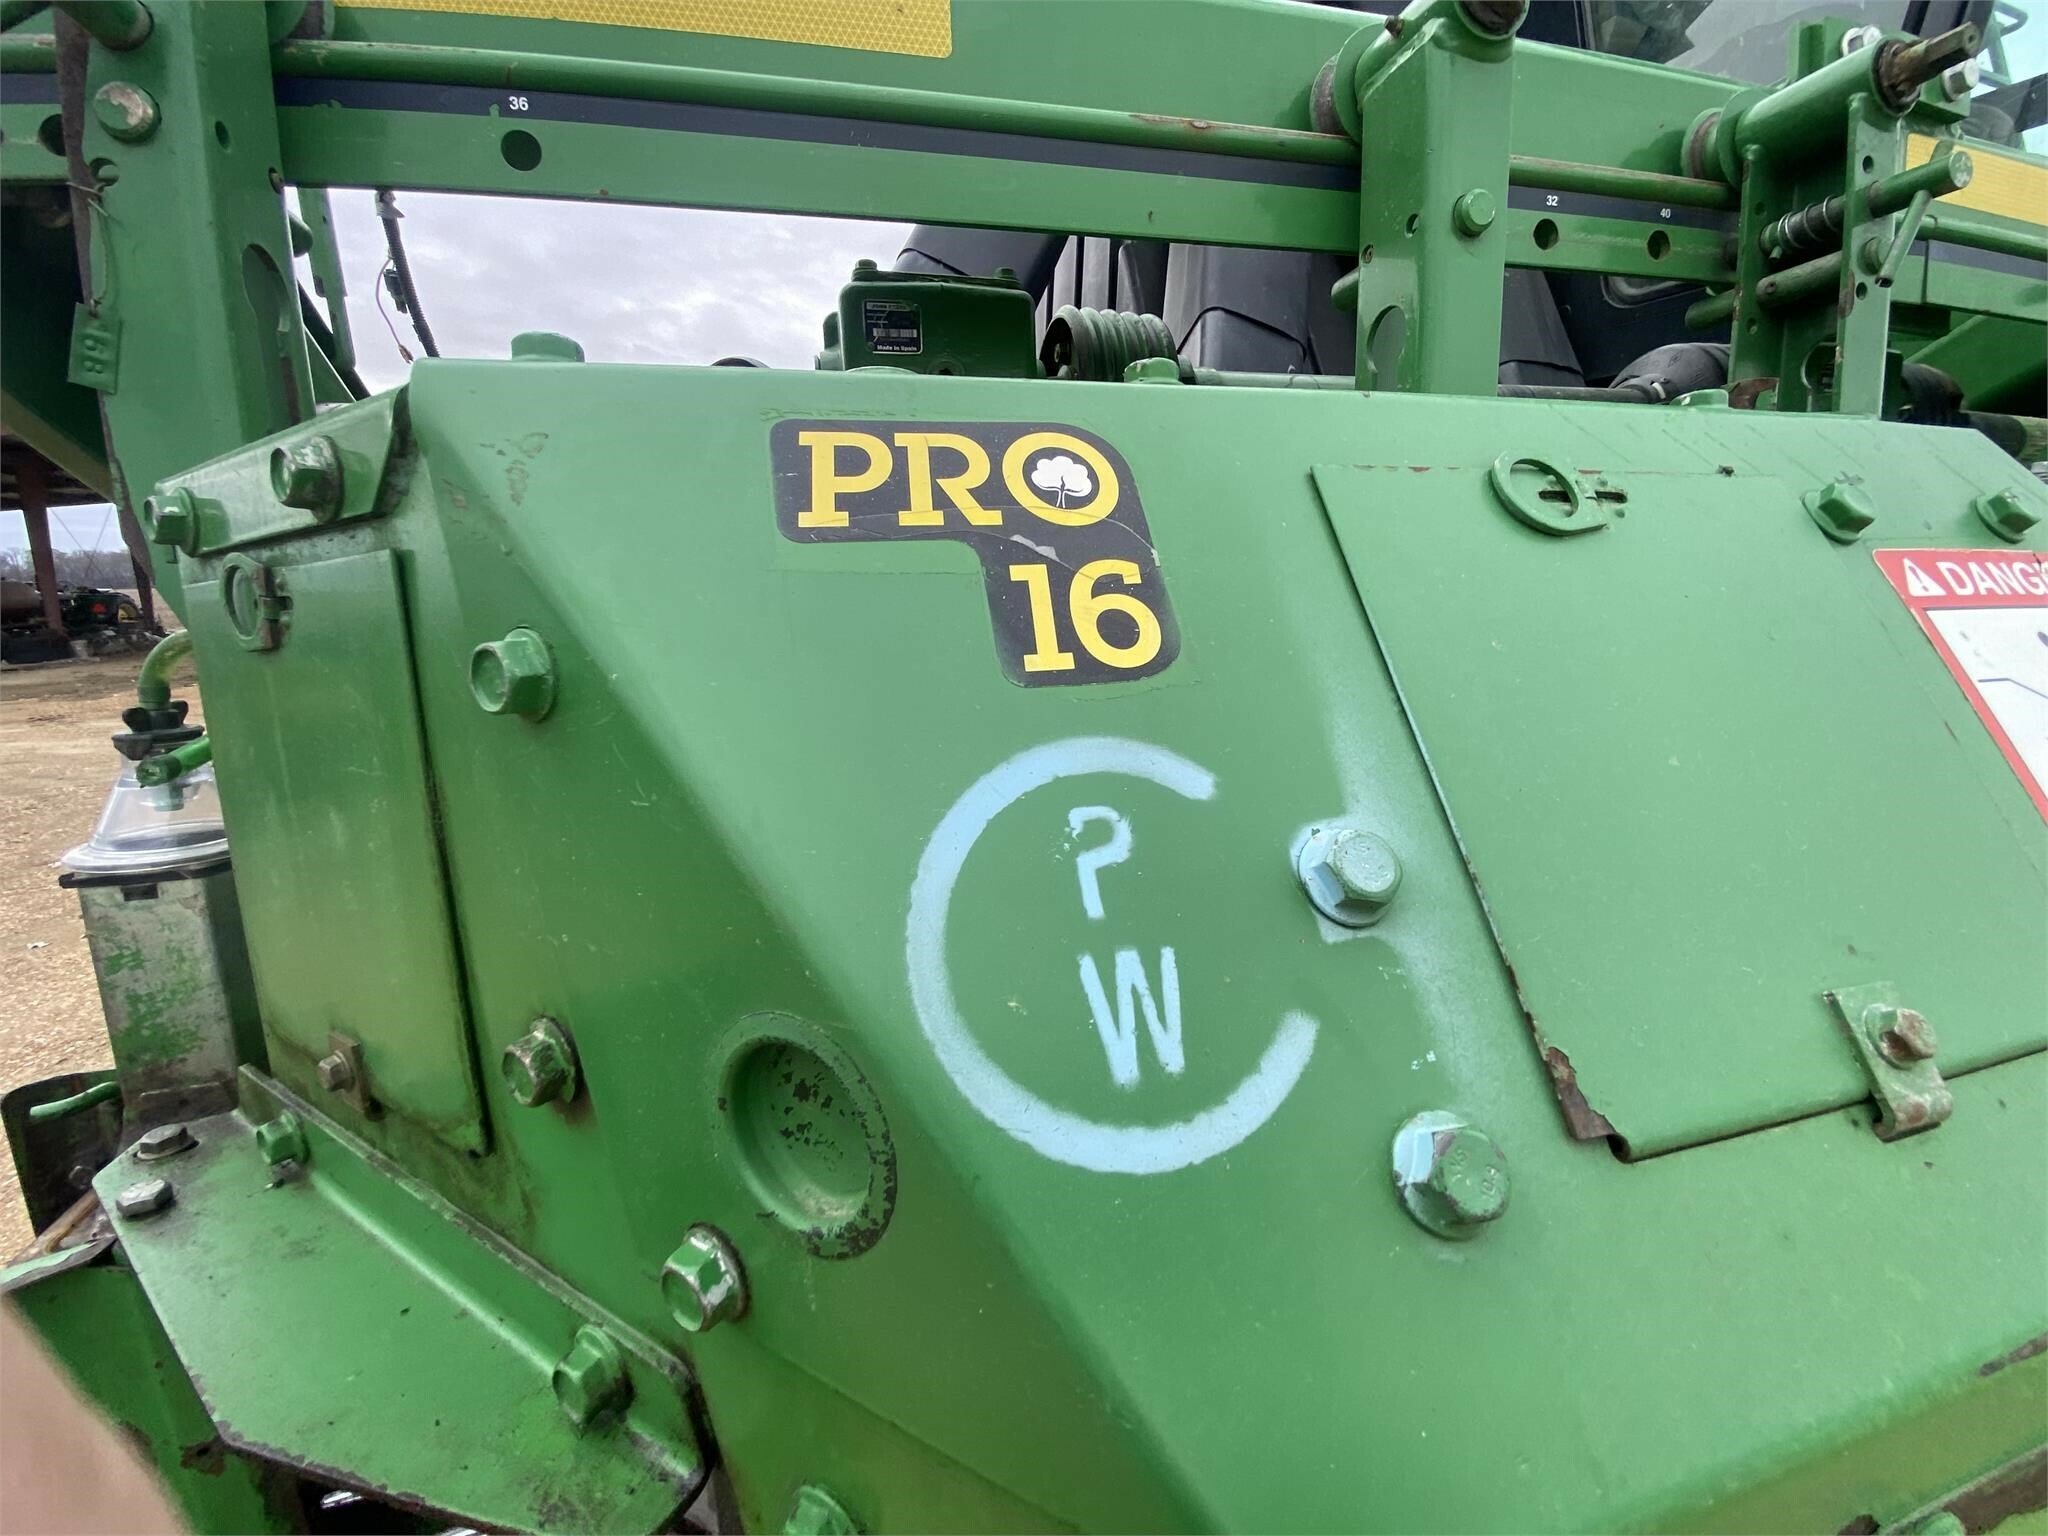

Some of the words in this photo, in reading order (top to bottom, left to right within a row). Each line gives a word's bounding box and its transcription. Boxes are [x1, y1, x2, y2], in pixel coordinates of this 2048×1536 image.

[508, 96, 529, 111] 36
[1545, 194, 1559, 207] 32
[1659, 207, 1672, 219] 40
[797, 431, 1120, 528] PRO
[1008, 559, 1162, 673] 16
[1077, 945, 1186, 1090] W
